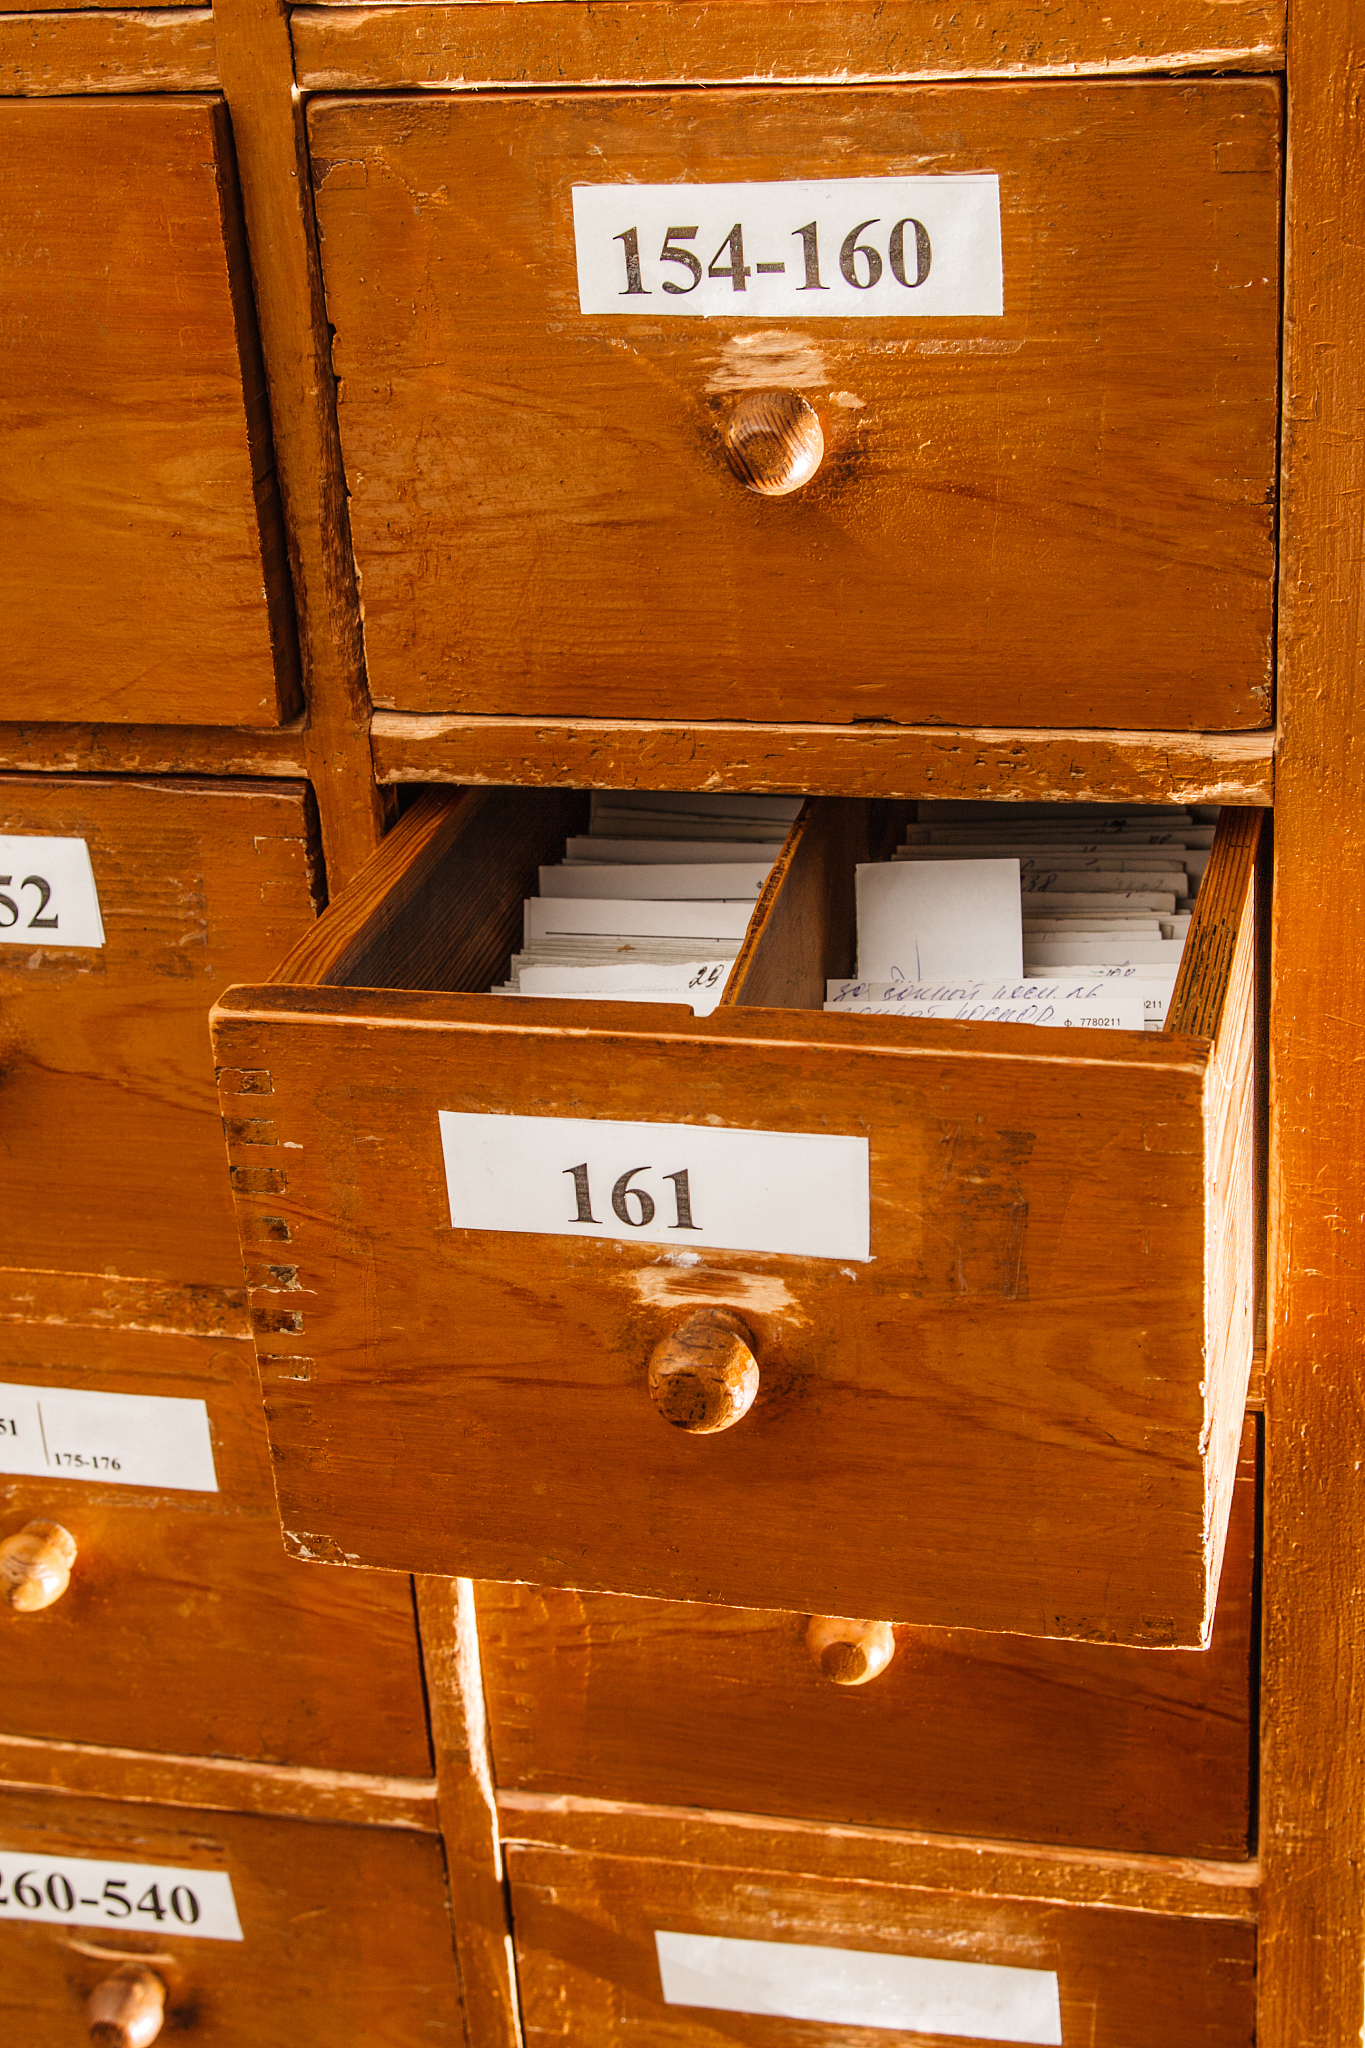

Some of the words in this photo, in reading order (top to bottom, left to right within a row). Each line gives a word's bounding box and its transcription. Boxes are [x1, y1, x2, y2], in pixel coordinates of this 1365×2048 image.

[612, 217, 932, 295] 154-160
[1080, 1018, 1121, 1027] 7780211
[1143, 1000, 1162, 1009] 211
[562, 1162, 703, 1231] 161
[54, 1452, 122, 1471] 175-176
[0, 1869, 200, 1925] 60-540
